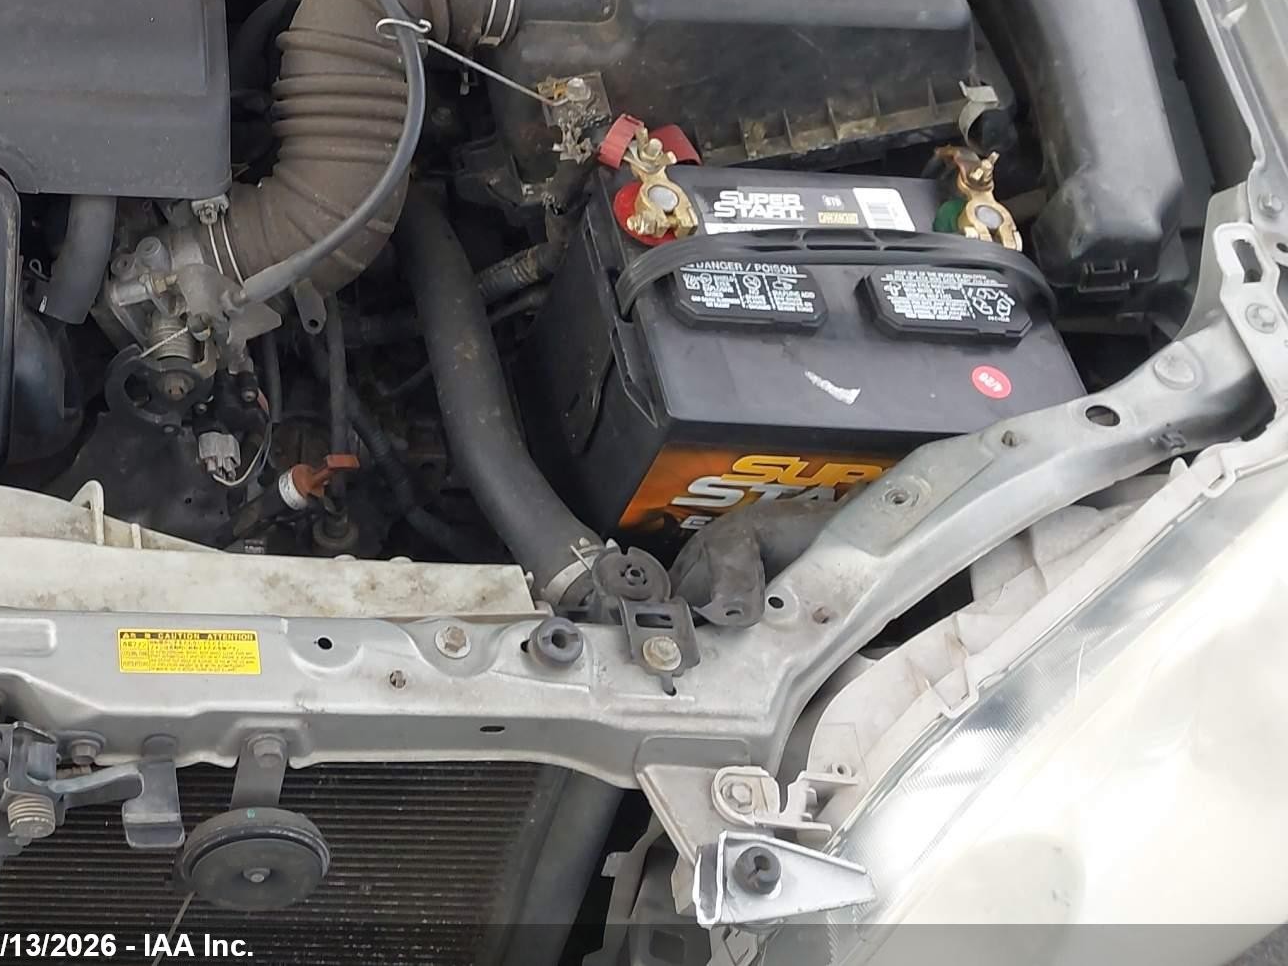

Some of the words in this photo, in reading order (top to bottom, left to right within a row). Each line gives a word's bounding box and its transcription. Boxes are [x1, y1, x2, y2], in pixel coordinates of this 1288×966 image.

[719, 191, 800, 206] SUPER
[714, 201, 804, 219] START
[754, 264, 798, 275] POISON
[720, 455, 885, 487] SUP
[671, 476, 848, 507] STA
[157, 632, 200, 640] CAUTION
[207, 633, 256, 641] ATTENTION
